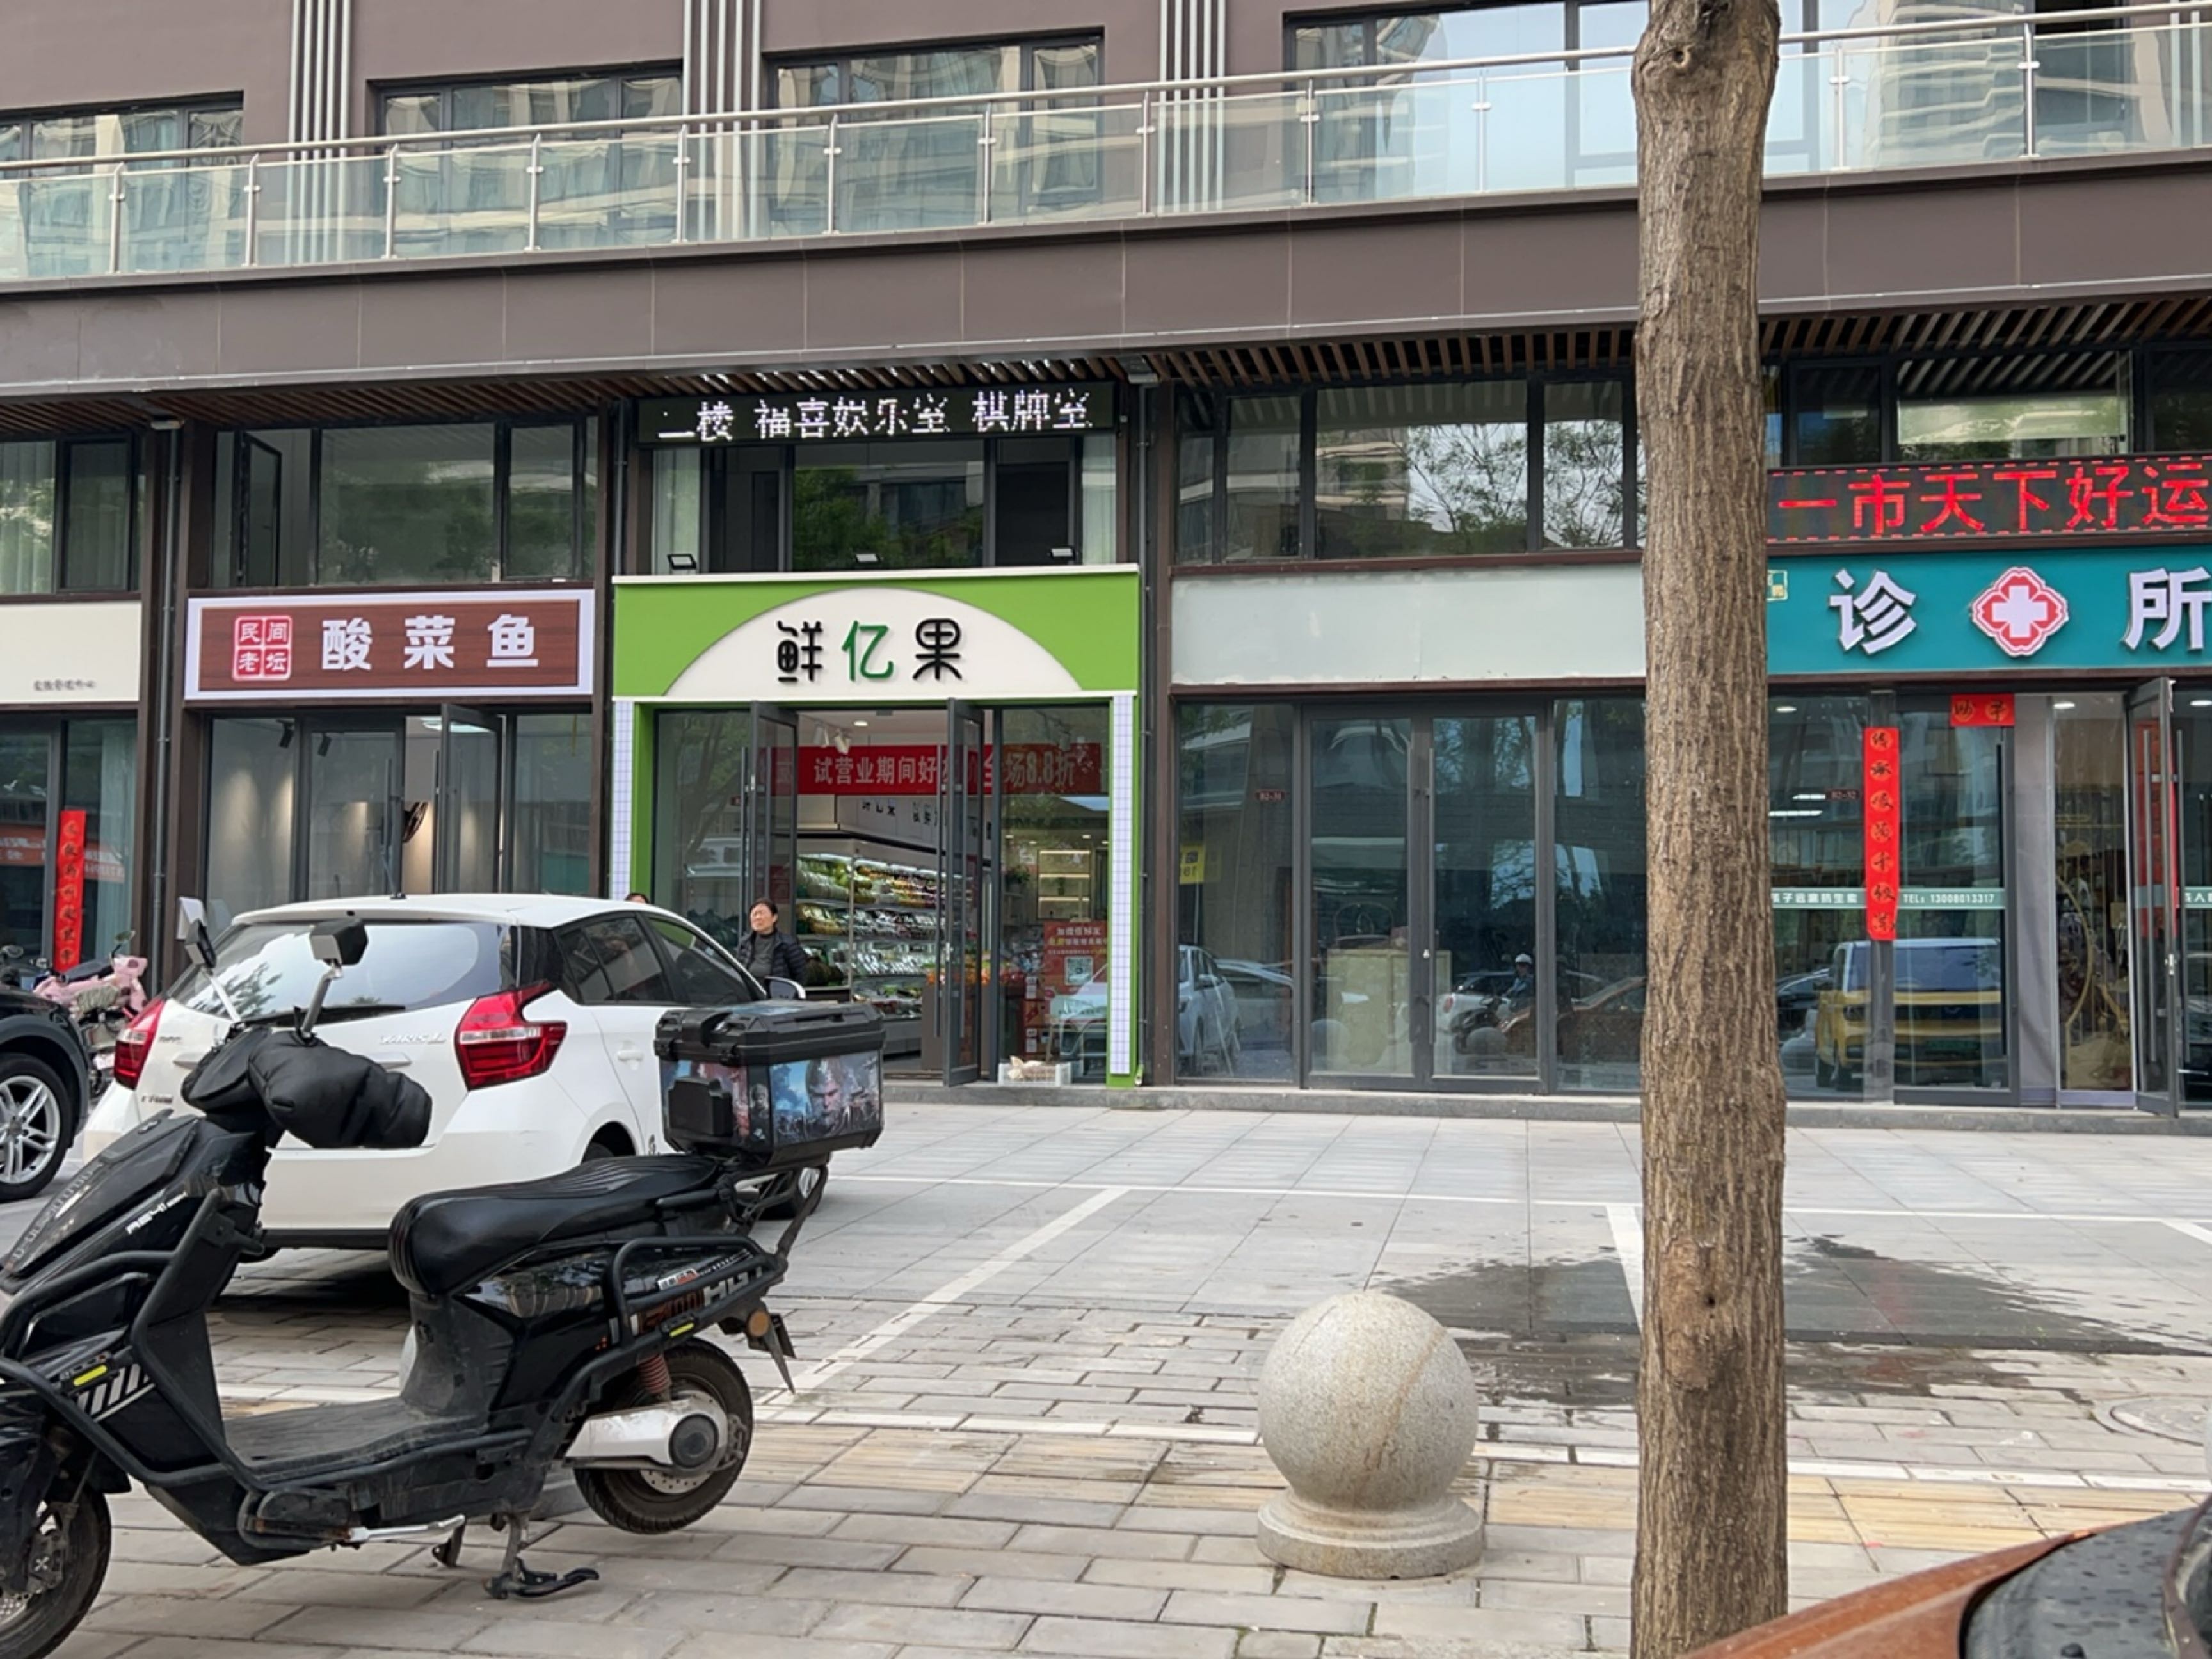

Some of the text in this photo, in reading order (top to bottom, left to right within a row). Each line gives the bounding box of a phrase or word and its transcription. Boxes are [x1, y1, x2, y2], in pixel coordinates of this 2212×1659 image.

[754, 393, 950, 438] 福喜娱乐室
[972, 388, 1093, 432] 棋牌室
[1778, 462, 2210, 534] 一市天下好运
[321, 613, 540, 672] 酸菜鱼
[776, 618, 963, 683] 鲜亿果
